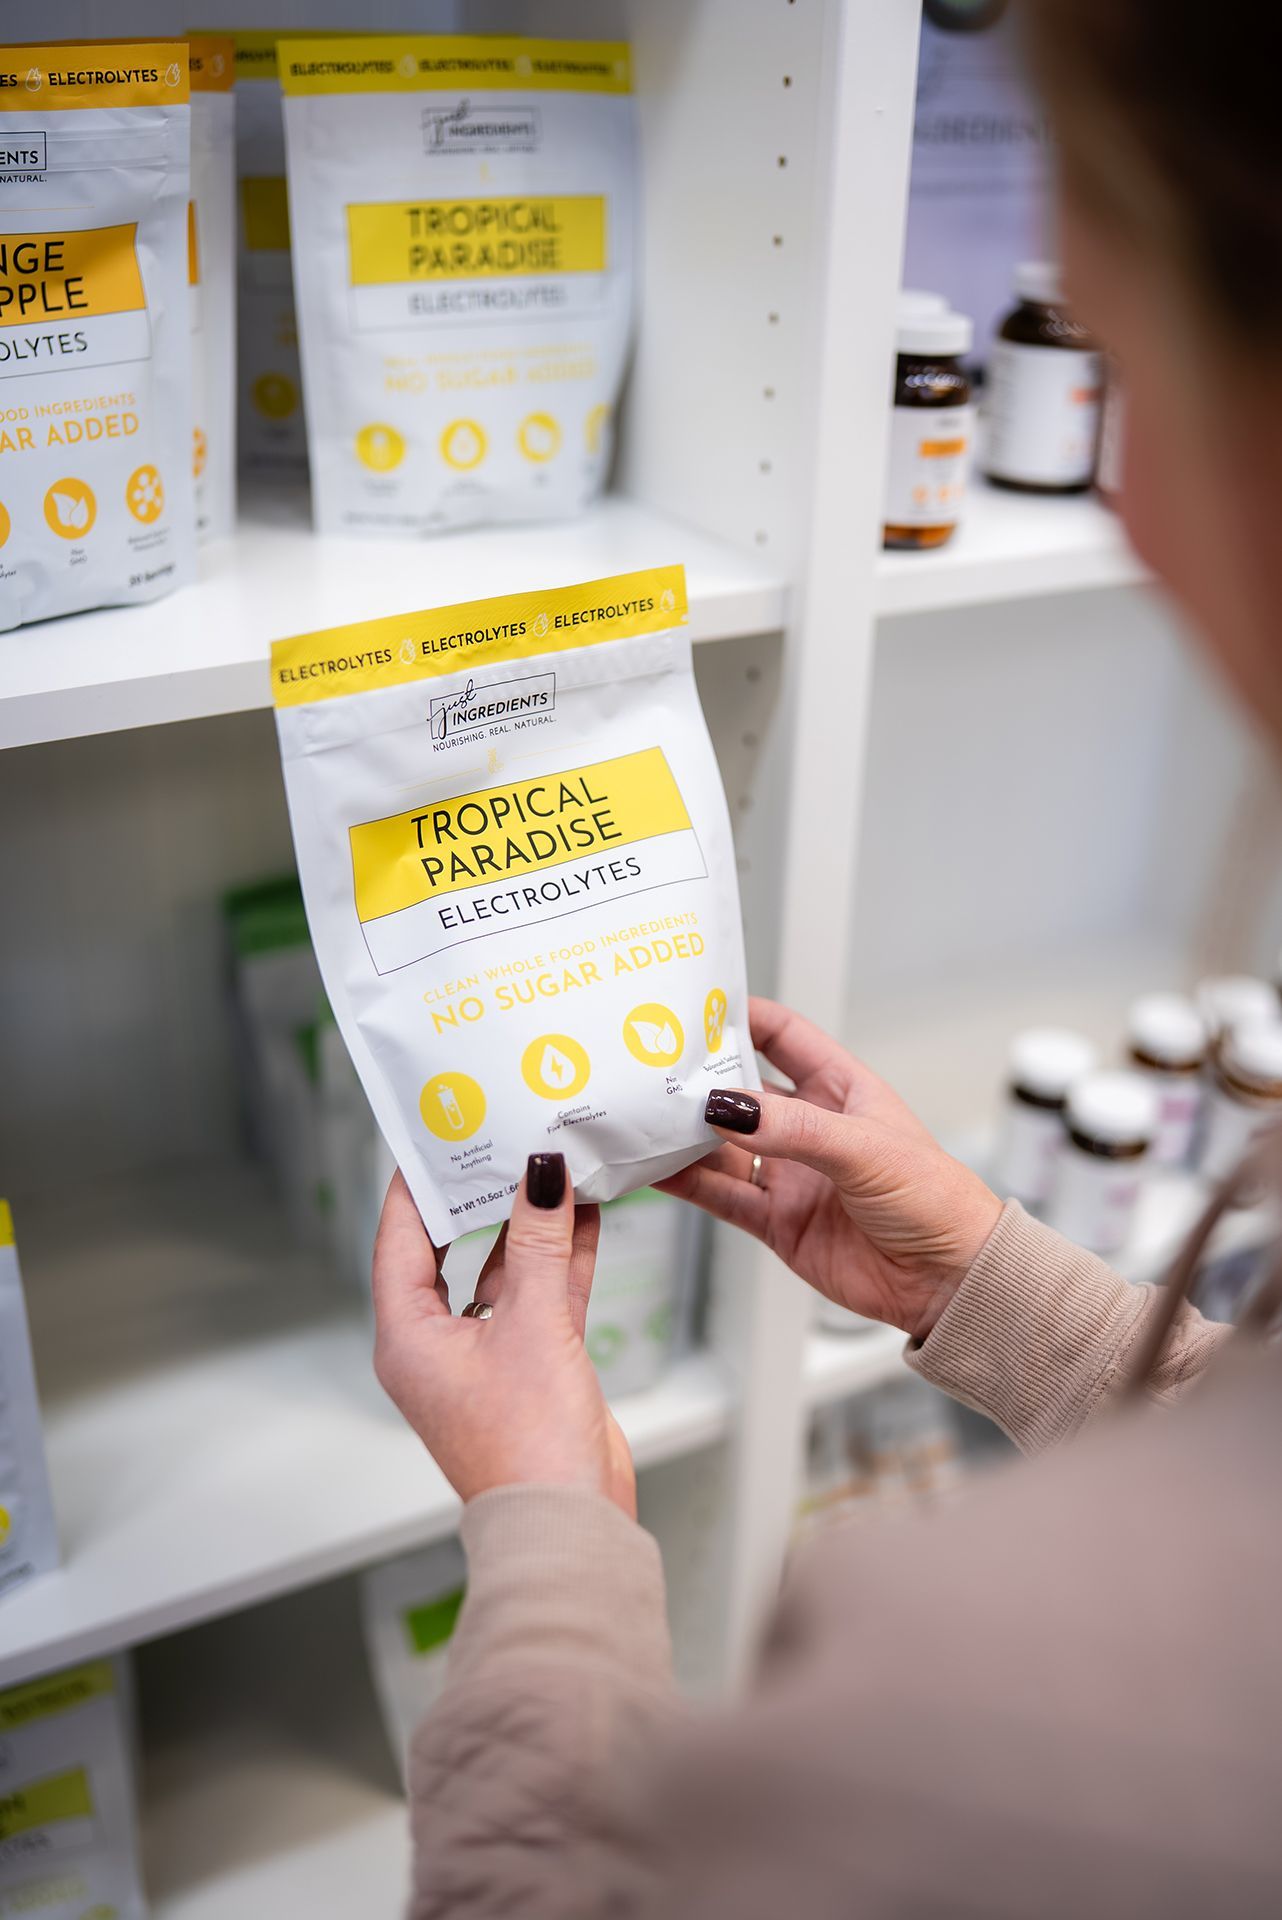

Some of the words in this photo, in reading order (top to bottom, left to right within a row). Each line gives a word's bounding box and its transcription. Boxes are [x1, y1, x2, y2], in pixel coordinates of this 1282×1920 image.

[48, 69, 158, 86] ELECTROLYTES
[406, 202, 562, 238] TROPICAL
[408, 238, 562, 276] PARADISE
[34, 392, 136, 418] INGREDIENTS
[47, 411, 140, 447] ADDED
[278, 648, 392, 684] ELECTROLYTES
[421, 622, 527, 656] ELECTROLYTES
[553, 598, 654, 630] ELECTROLYTES
[426, 679, 477, 740] just
[453, 692, 549, 726] INGREDIENTS
[433, 731, 487, 752] NOURISHING.
[490, 724, 512, 736] REAL.
[514, 715, 557, 730] NATURAL.
[411, 777, 609, 849] TROPICAL
[421, 810, 622, 887] PARADISE
[438, 857, 642, 930] ELECTROLYTES
[423, 975, 480, 1004] CLEAN
[484, 954, 544, 981] WHOLE
[550, 940, 596, 963] FOOD
[600, 912, 698, 948] INGREDIENTS
[431, 997, 485, 1034] NO
[495, 961, 603, 1010] SUGAR
[614, 932, 705, 976] ADDED
[557, 1103, 591, 1119] Contains
[563, 1110, 607, 1127] Electrolytes
[451, 1154, 462, 1163] No
[463, 1139, 493, 1158] Artificial
[460, 1154, 492, 1171] Anything
[449, 1205, 463, 1216] Net
[464, 1201, 476, 1211] Wt
[476, 1190, 503, 1205] 10.5oz
